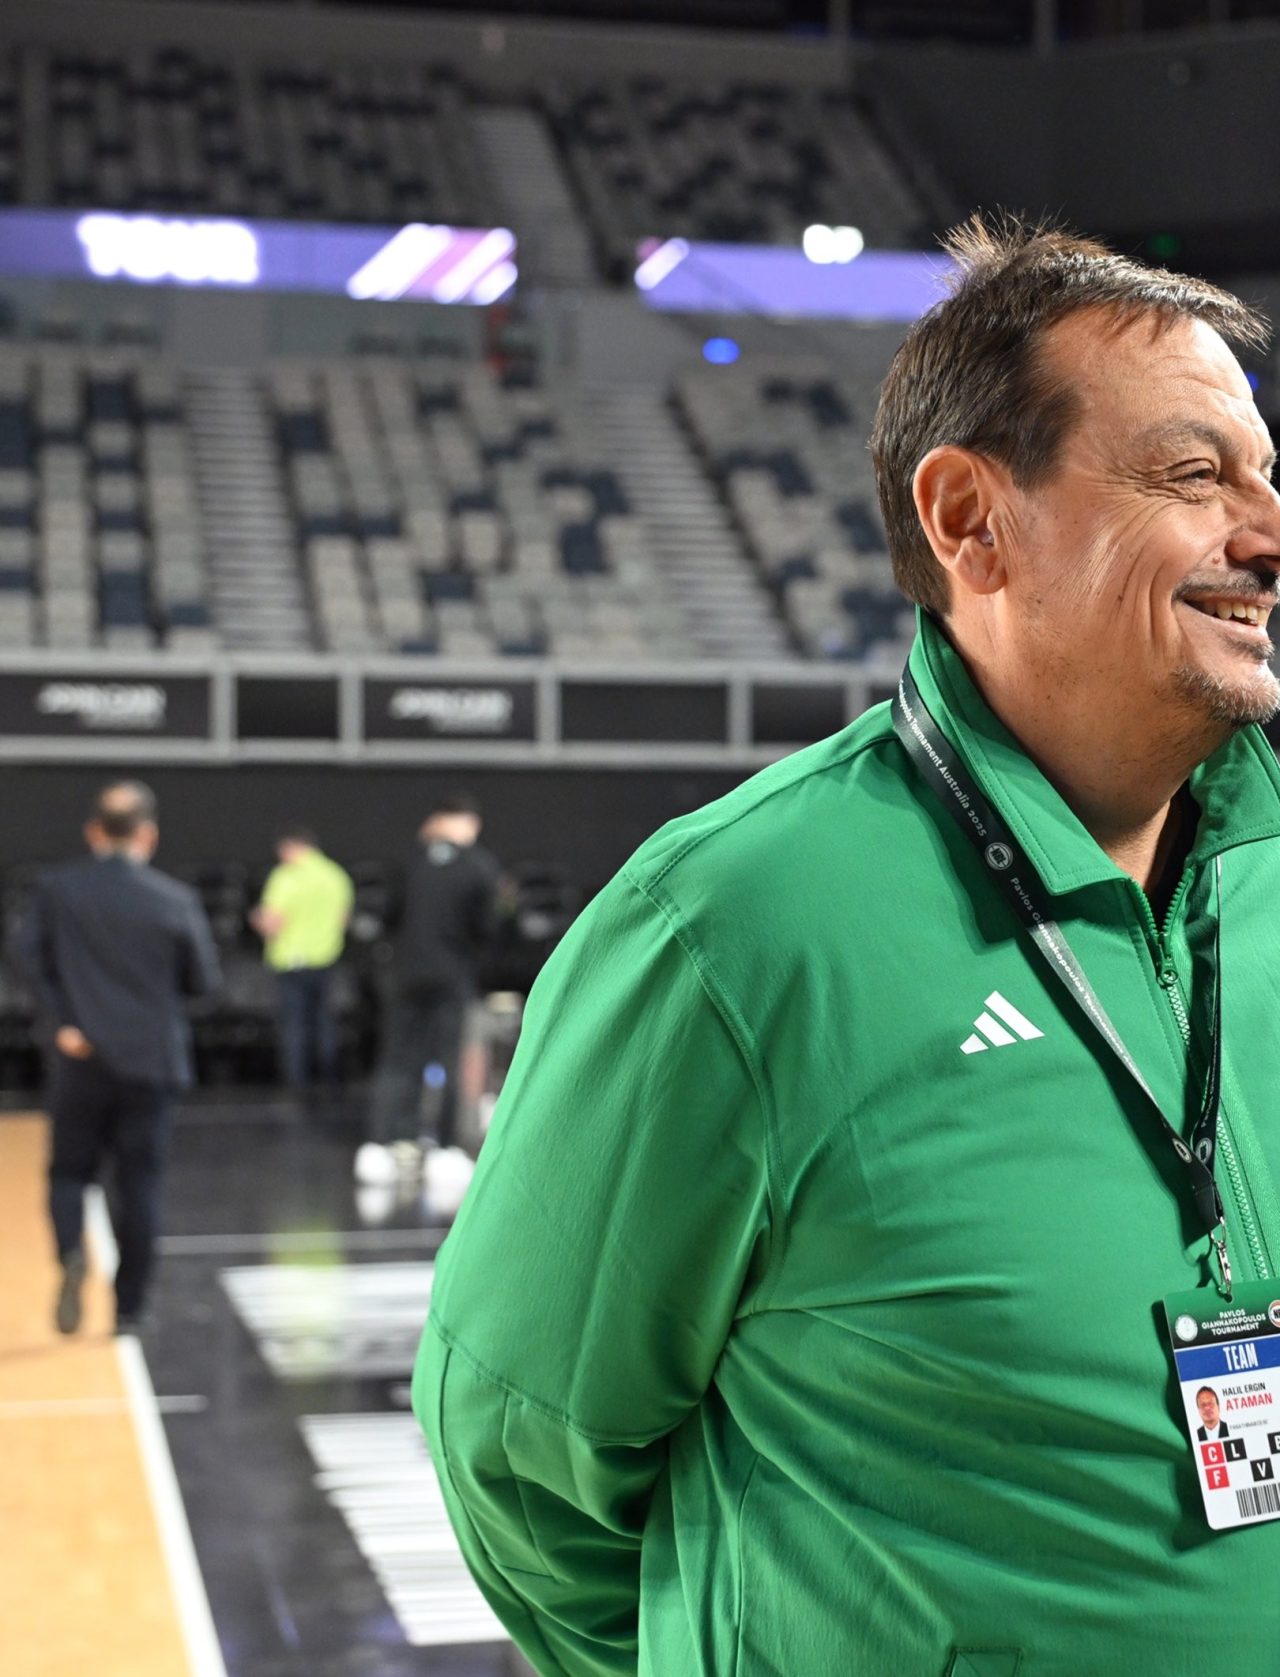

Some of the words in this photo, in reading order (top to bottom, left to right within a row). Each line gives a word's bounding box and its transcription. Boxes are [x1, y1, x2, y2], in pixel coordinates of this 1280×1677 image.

[910, 718, 942, 767] Tournament
[939, 766, 970, 809] Australia
[968, 810, 987, 836] 2025
[1010, 877, 1034, 911] Pavlos
[1201, 1313, 1266, 1329] GIANNAKOPOULOS
[1219, 1308, 1246, 1319] PAVLOS
[1211, 1322, 1259, 1335] TOURNAMENT
[1222, 1343, 1258, 1371] TEAM
[1222, 1386, 1243, 1396] HALIL
[1244, 1382, 1266, 1393] ERGIN
[1226, 1392, 1273, 1411] ATAMAN
[1207, 1446, 1218, 1462] C
[1230, 1443, 1240, 1458] L
[1213, 1470, 1221, 1486] F
[1256, 1461, 1266, 1478] V
